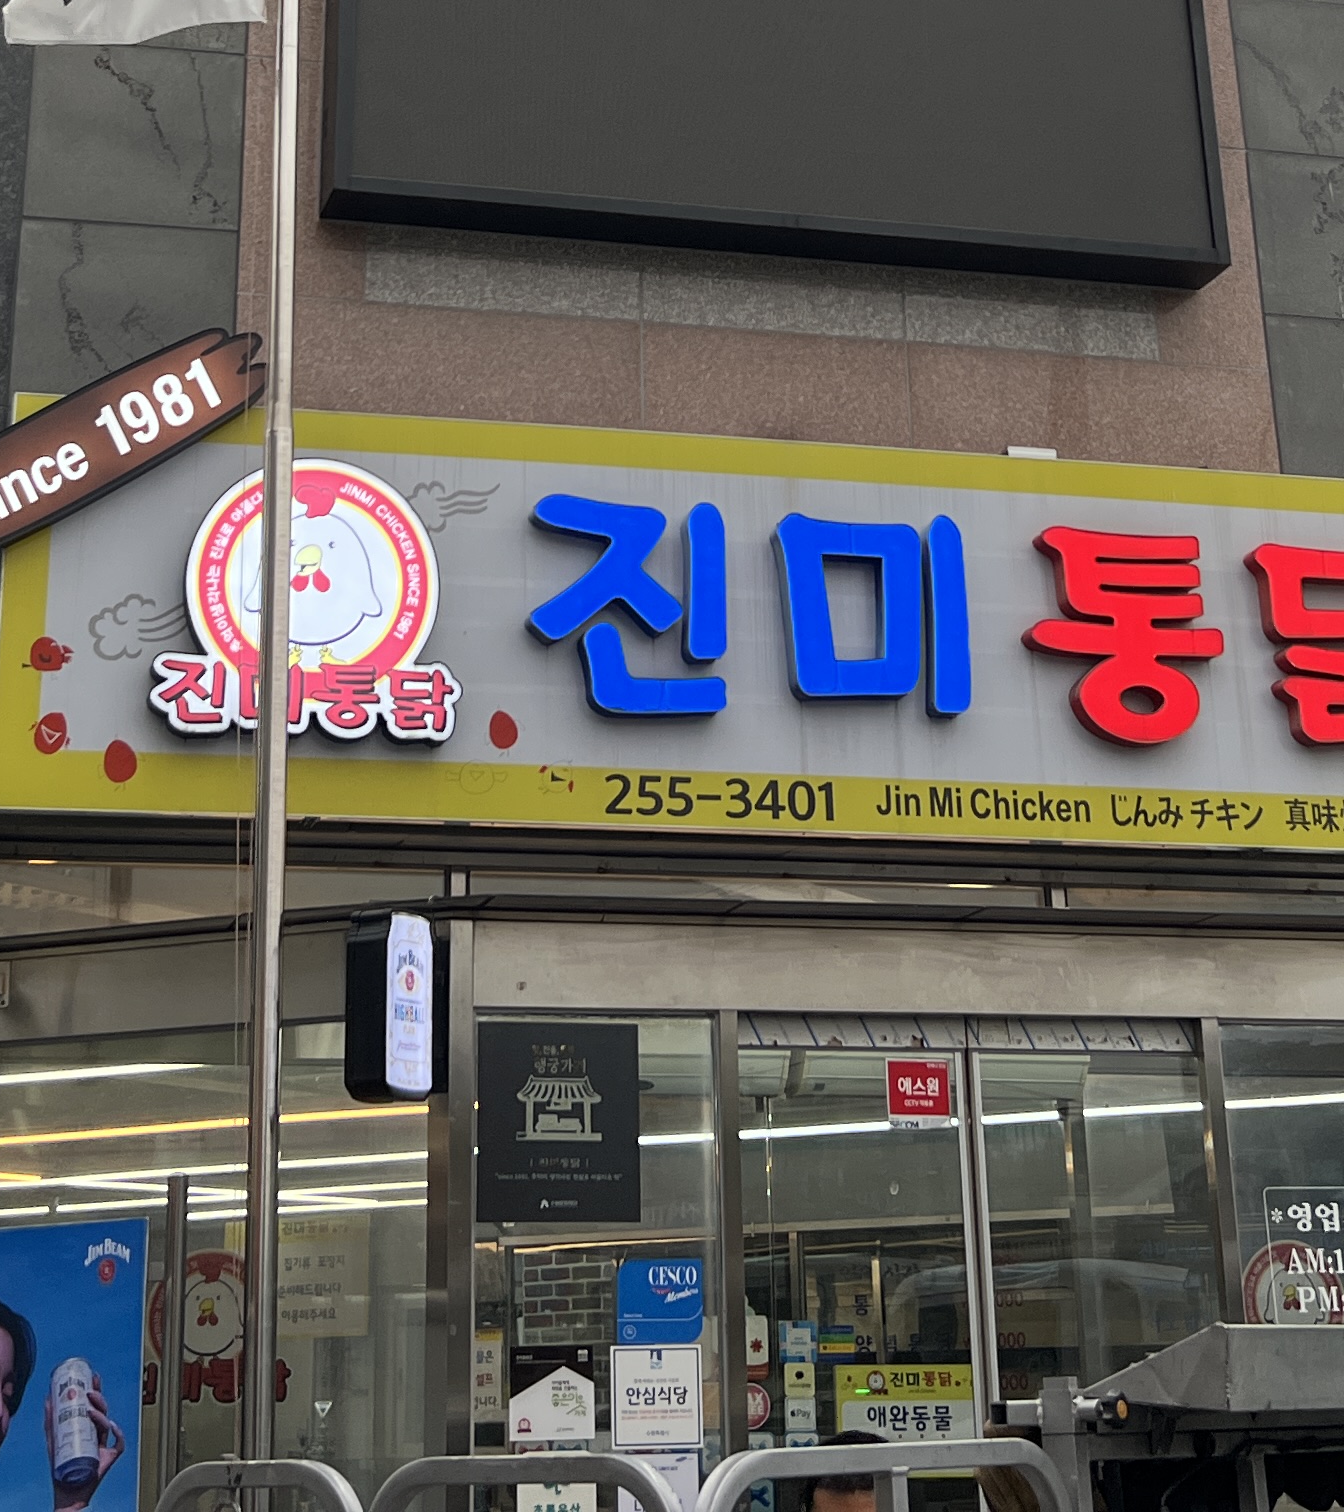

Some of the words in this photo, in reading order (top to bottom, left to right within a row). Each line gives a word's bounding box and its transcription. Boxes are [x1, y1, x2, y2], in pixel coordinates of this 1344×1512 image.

[94, 357, 225, 457] 1981
[339, 482, 377, 508] JINMI
[209, 522, 236, 561] 진실로
[375, 504, 417, 561] CHICKEN
[406, 563, 421, 608] SINCE
[393, 611, 416, 641] 1981
[603, 771, 837, 825] 255-3401
[875, 781, 923, 819] Jin
[929, 782, 965, 820] Mi
[968, 784, 1093, 826] Chicken
[897, 1076, 940, 1097] 에스원
[84, 1241, 104, 1267] JIM
[104, 1238, 131, 1264] BEAM
[648, 1265, 698, 1286] CESCO
[889, 1371, 953, 1388] 진미통닭
[625, 1385, 689, 1407] 안심식당
[796, 1408, 812, 1419] Pay
[866, 1405, 954, 1432] 애완동물
